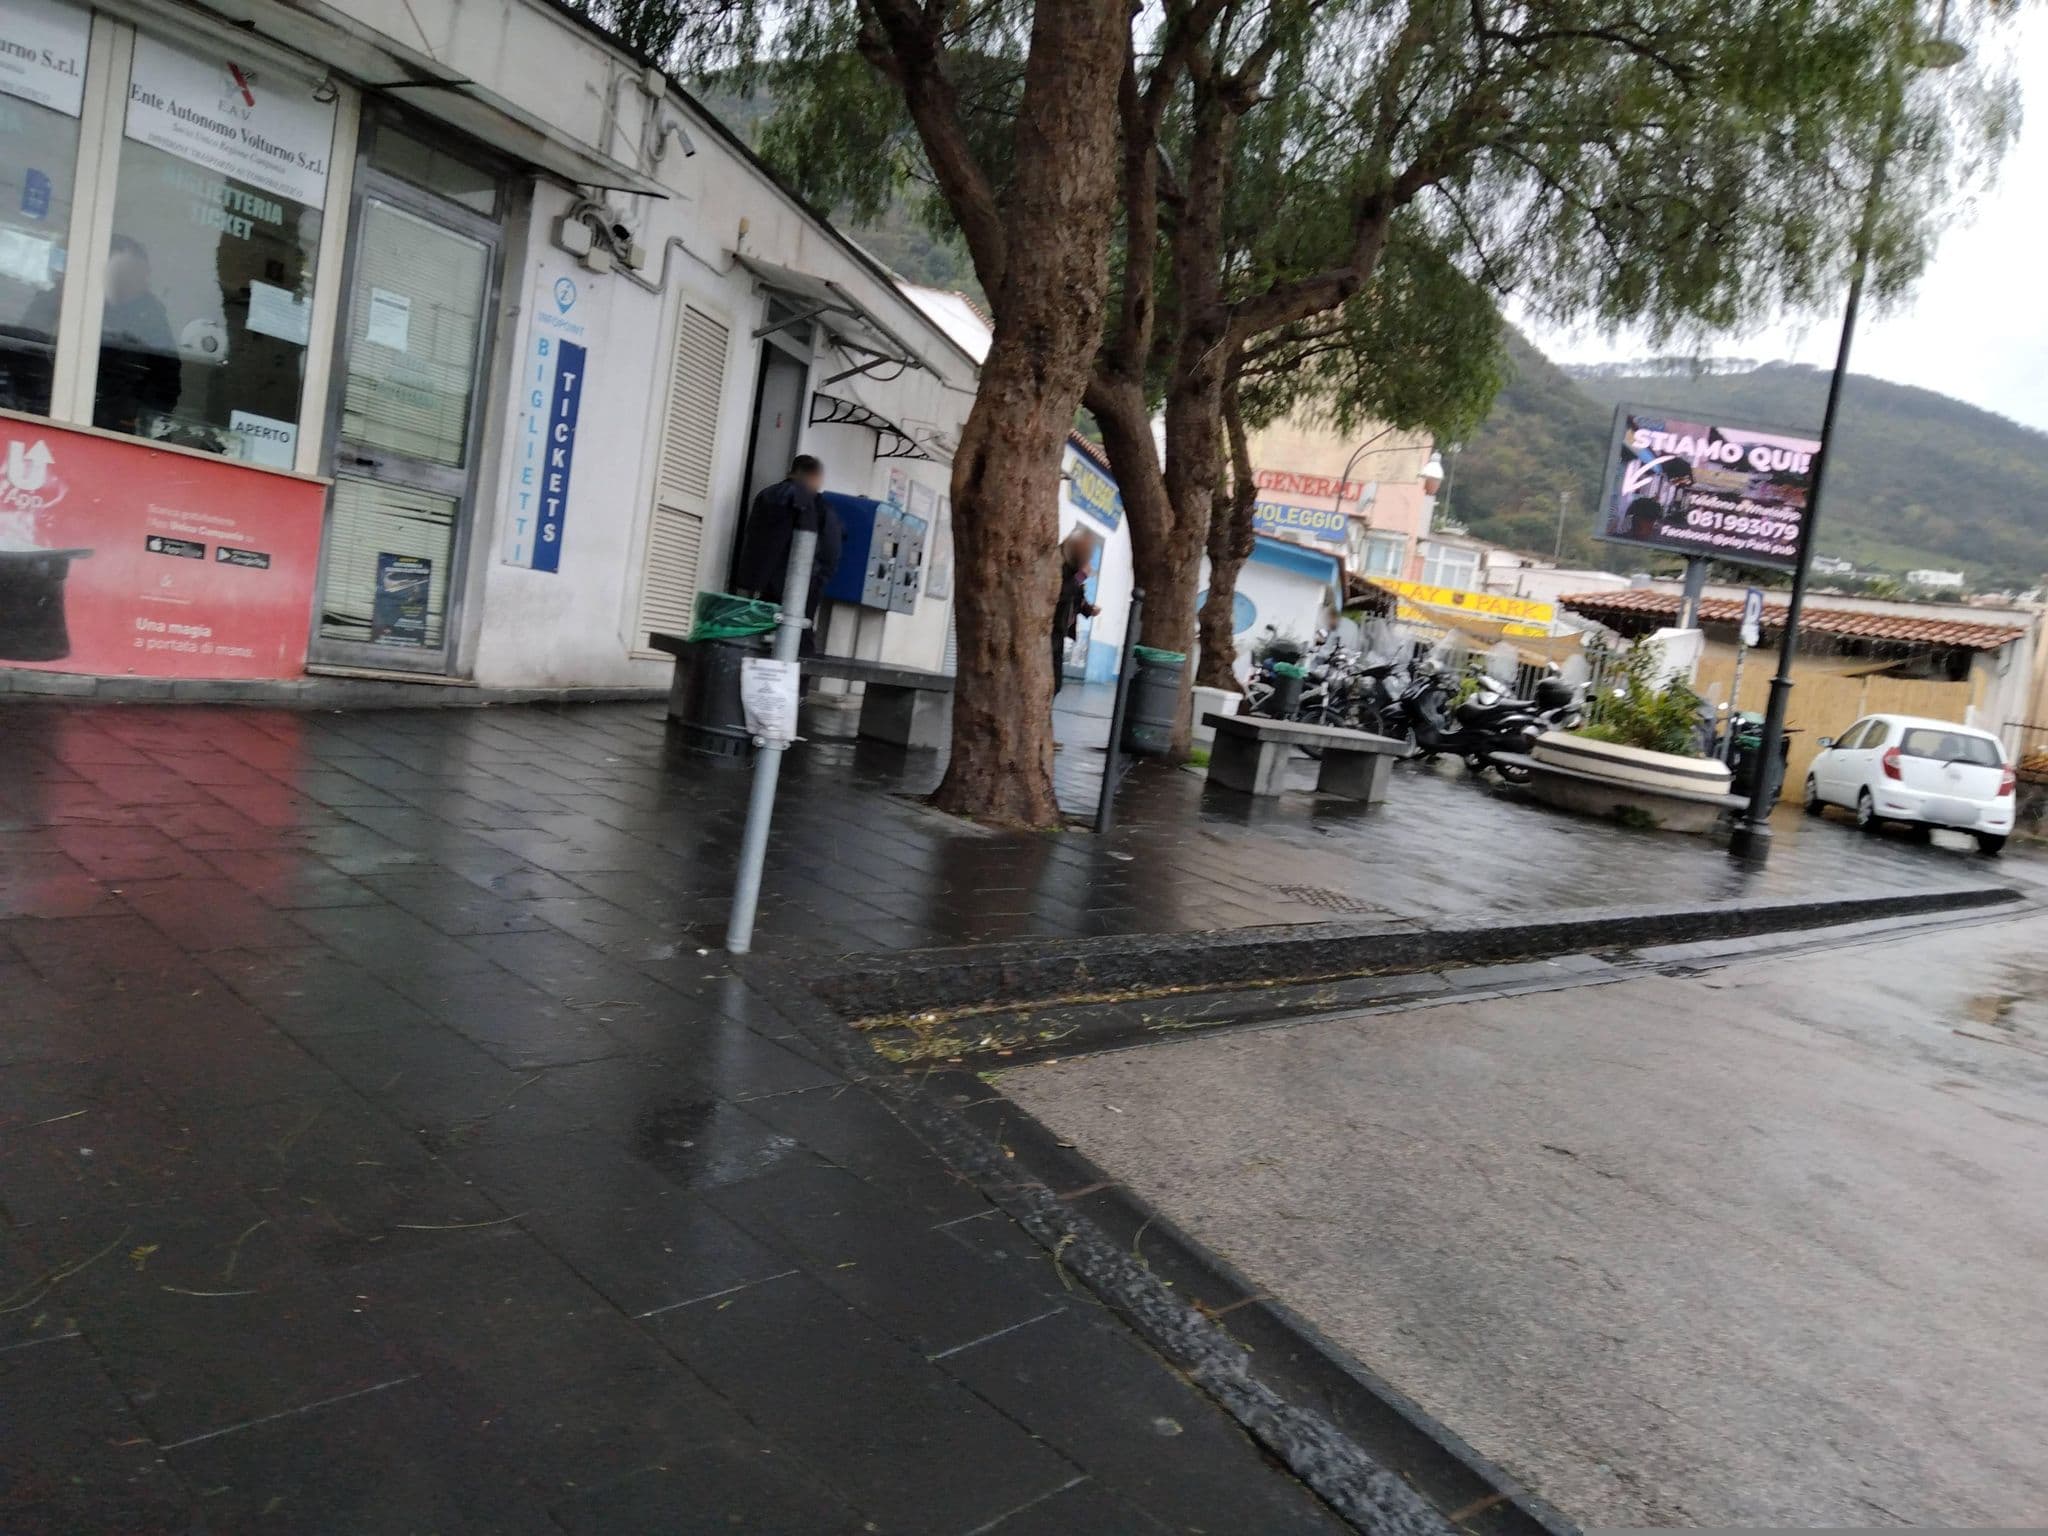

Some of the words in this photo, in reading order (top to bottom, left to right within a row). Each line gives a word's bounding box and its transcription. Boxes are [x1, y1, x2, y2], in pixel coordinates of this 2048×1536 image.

[40, 48, 79, 77] S.r.l.
[131, 83, 164, 111] Ente
[166, 100, 237, 140] Autonomo
[240, 127, 295, 164] Volturno
[297, 151, 324, 176] S.r.l.
[235, 421, 290, 443] APERTO
[515, 338, 549, 561] BIGLIETTI
[543, 371, 576, 543] TICKETS
[1632, 429, 1744, 466] STIAMO
[1747, 447, 1812, 475] QUI!
[1258, 470, 1364, 502] GENERALI
[1687, 509, 1799, 541] 081993079
[1476, 595, 1538, 617] PARK
[136, 617, 166, 633] Una
